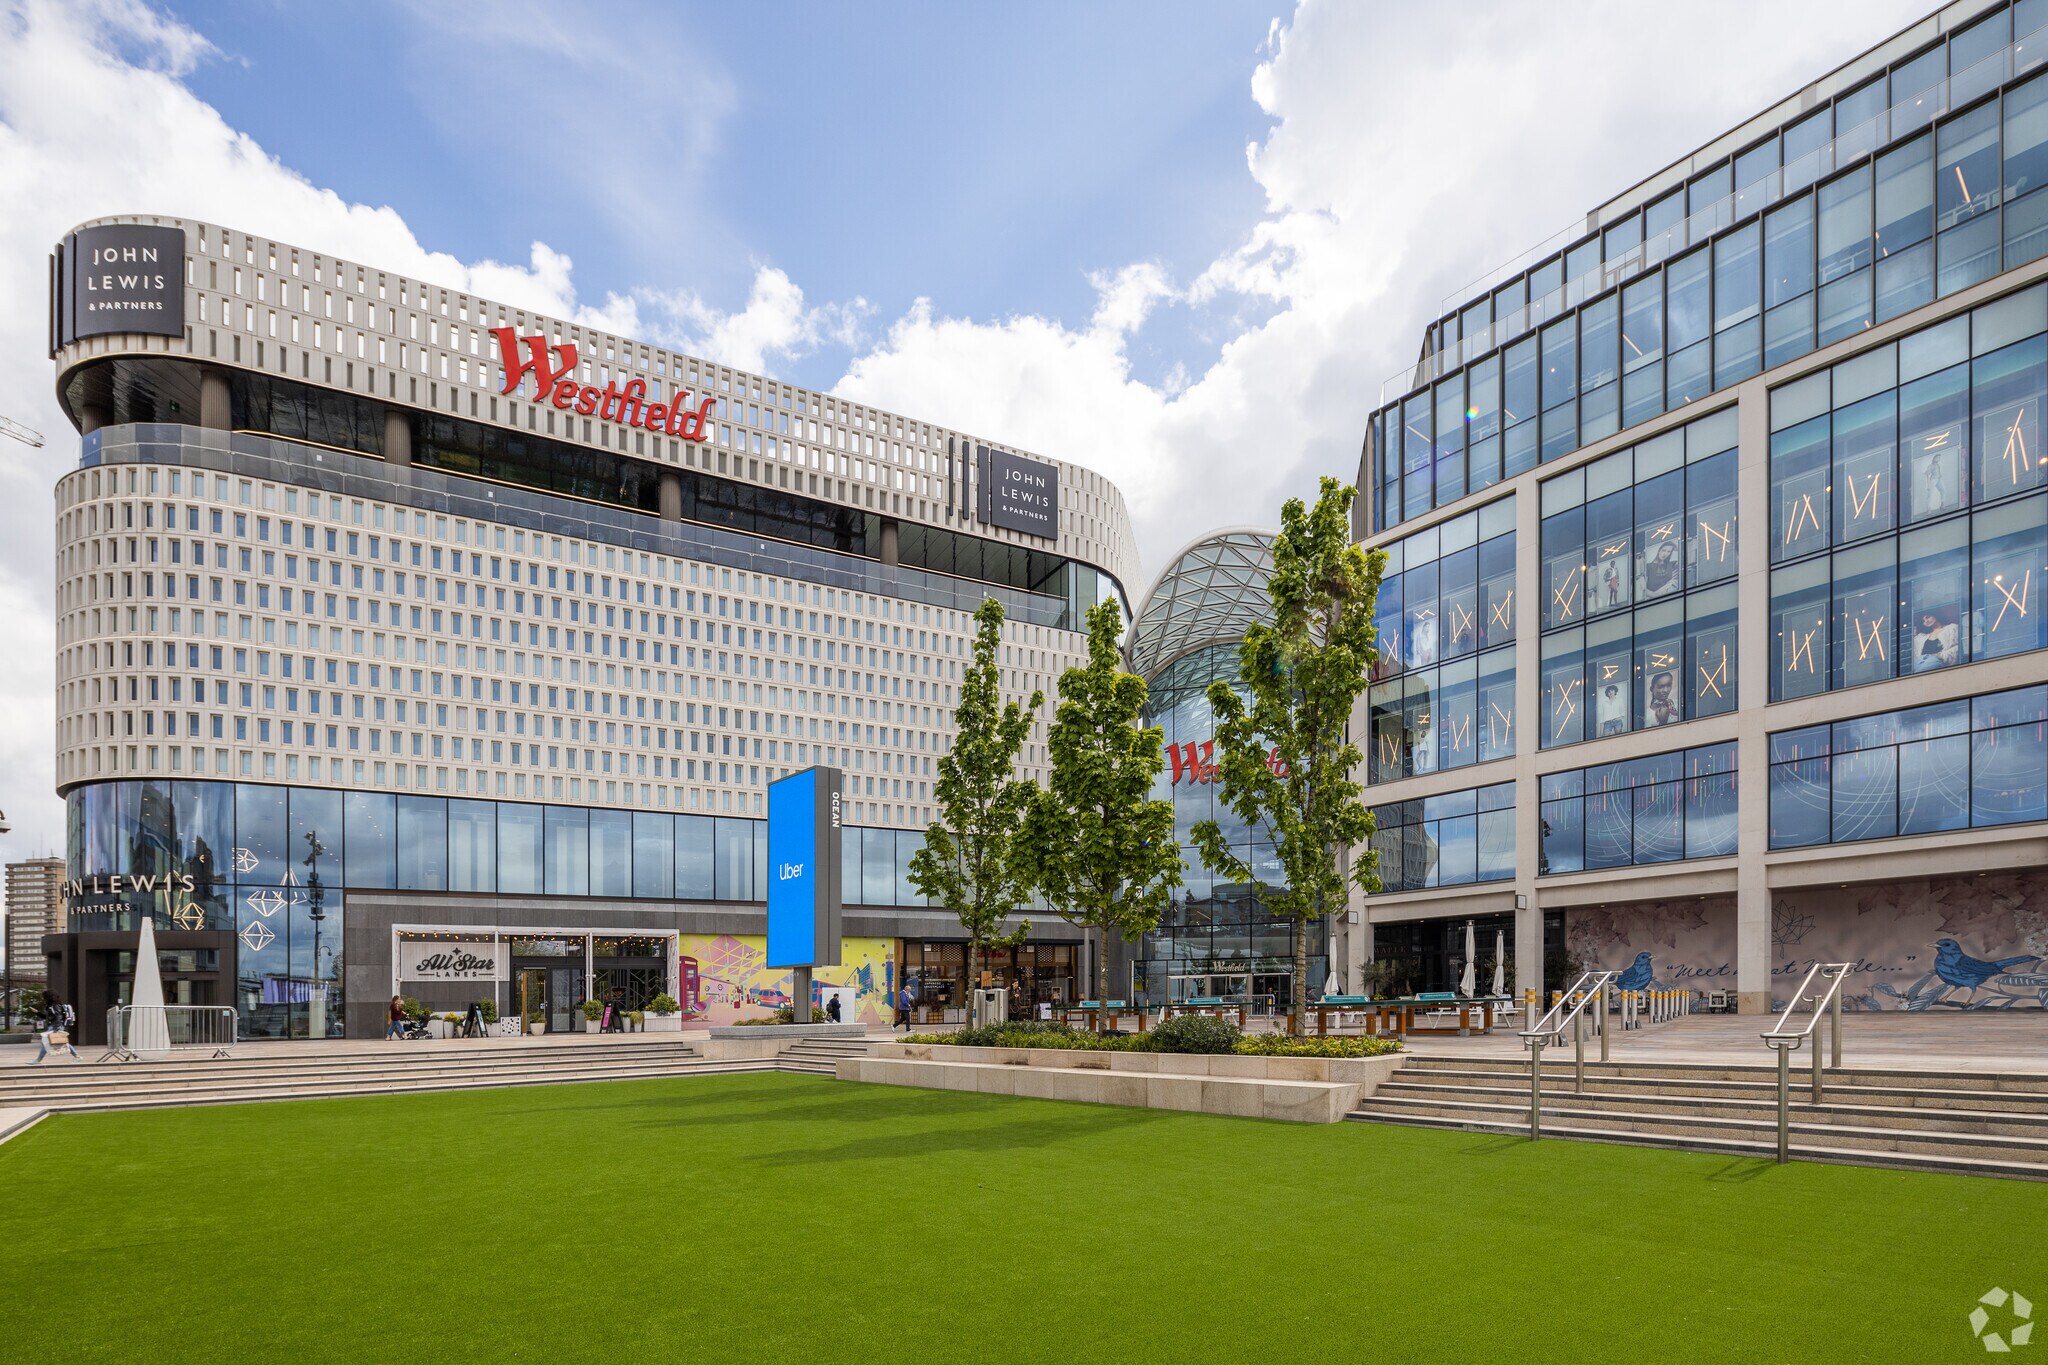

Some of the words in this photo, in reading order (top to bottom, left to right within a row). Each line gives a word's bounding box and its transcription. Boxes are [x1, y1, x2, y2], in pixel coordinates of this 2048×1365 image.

[93, 247, 158, 266] JOHN
[87, 275, 165, 291] LEWIS
[88, 303, 96, 312] &
[98, 301, 163, 311] PARTNERS
[488, 326, 717, 442] Westfield
[1005, 468, 1045, 488] JOHN
[1001, 486, 1049, 507] LEWIS
[1009, 506, 1048, 521] PARTNERS
[832, 791, 840, 828] OCEAN
[779, 863, 804, 881] Uber
[93, 874, 195, 895] LEWIS
[76, 902, 131, 914] PARTNERS
[416, 953, 453, 972] All
[453, 953, 495, 972] Star
[1212, 960, 1246, 973] Westfield
